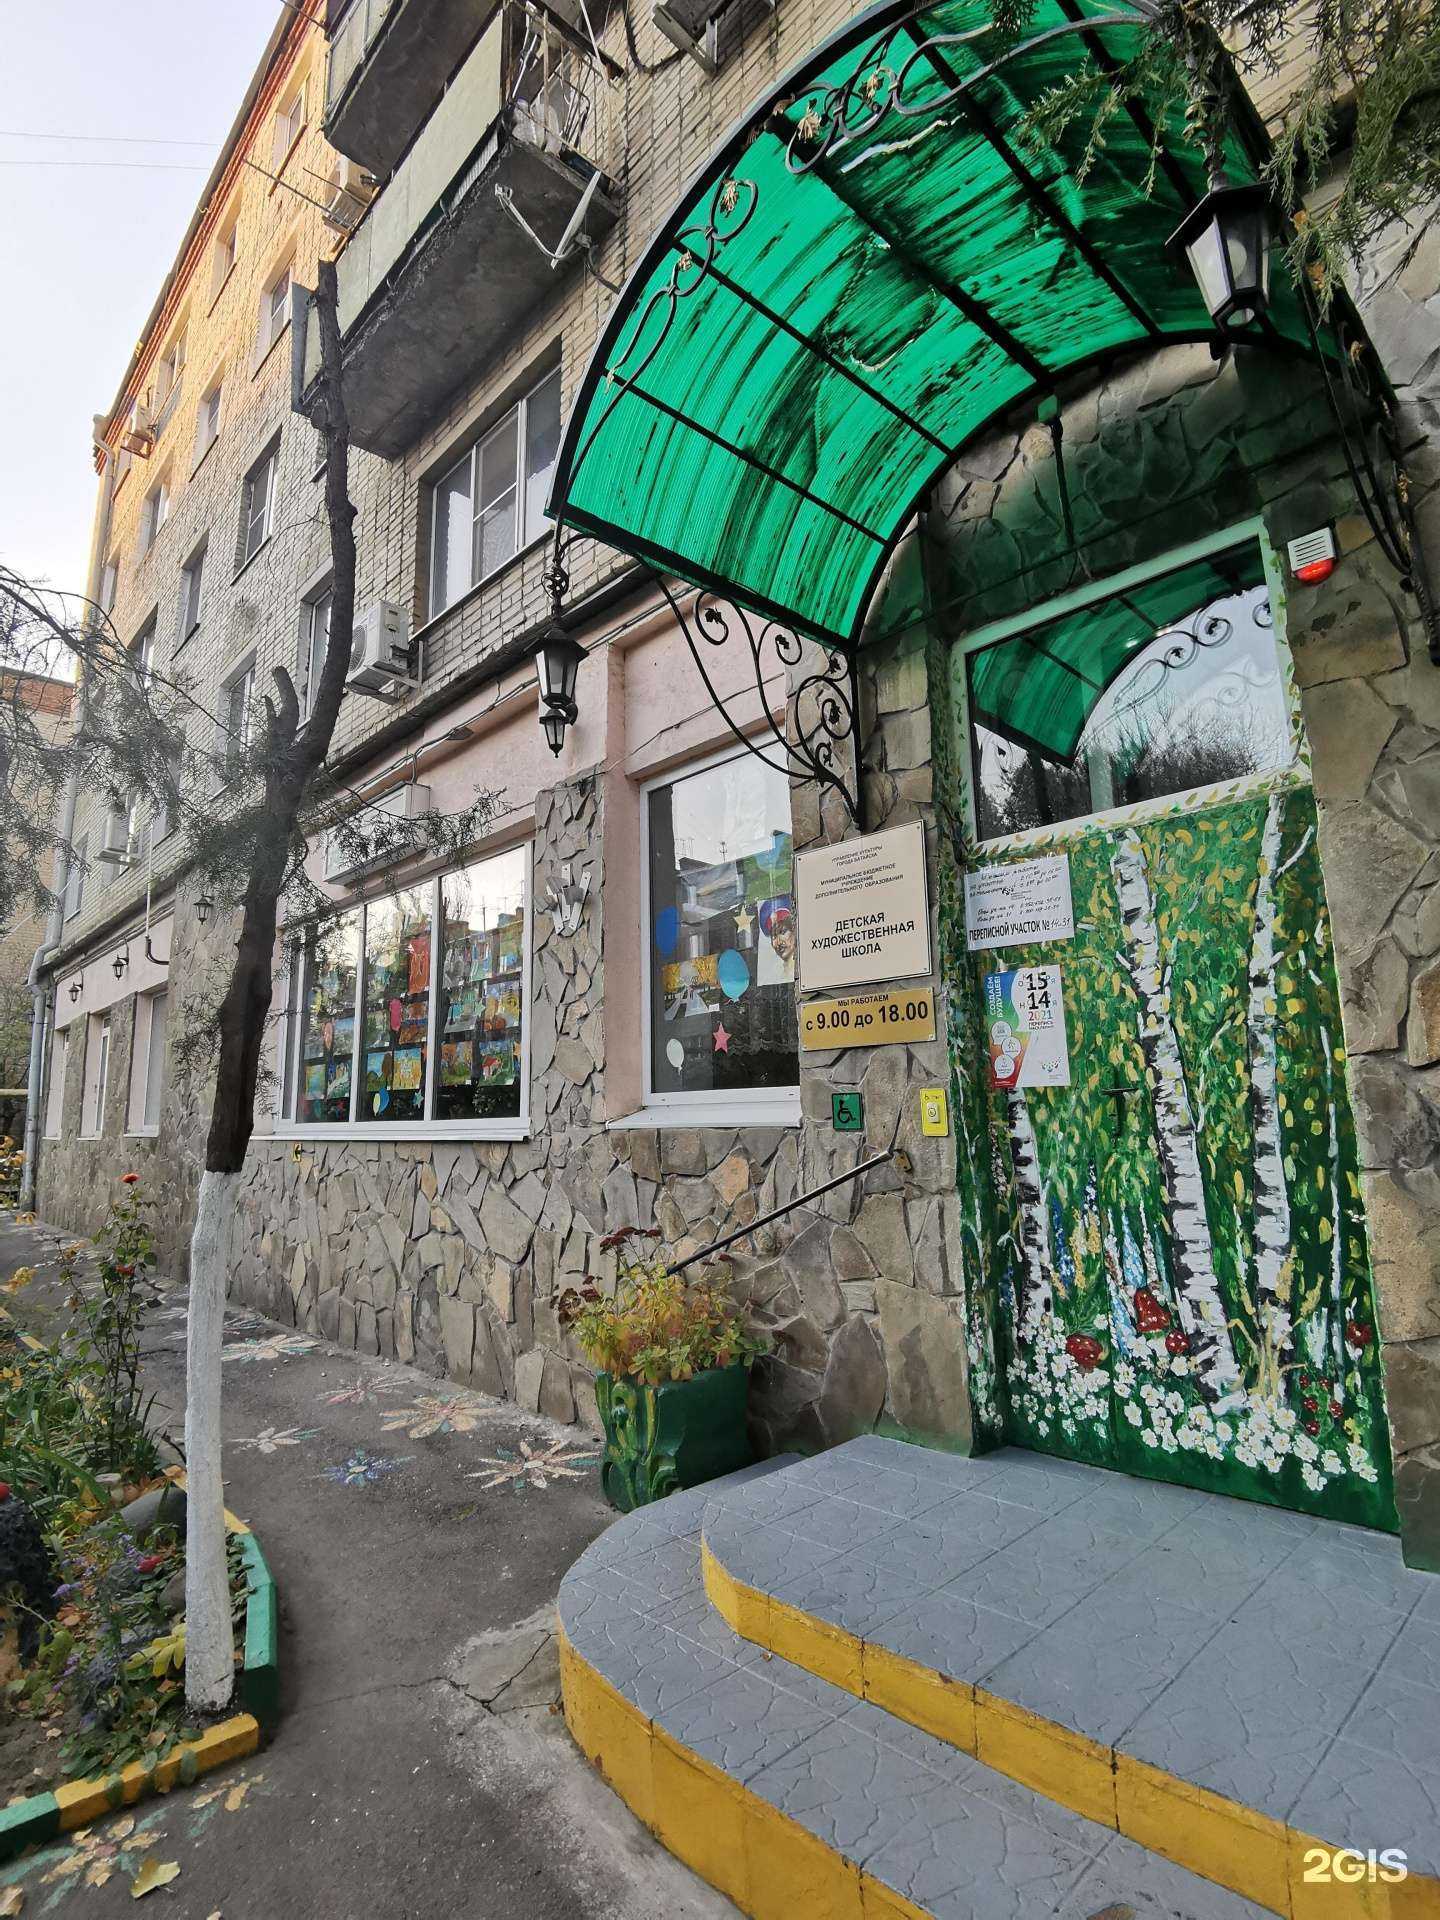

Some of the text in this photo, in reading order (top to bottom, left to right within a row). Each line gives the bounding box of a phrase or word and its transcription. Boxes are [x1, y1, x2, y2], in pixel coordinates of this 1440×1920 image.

[820, 863, 896, 886] МУНИЦИПАЛЬНОЕ БЮДЖЕТНОЕ
[841, 875, 874, 887] УЧРЕЖДЕНИЕ
[815, 874, 904, 900] ДОПОЛНИТЕЛЬНОГО ОБРАЗОВАНИЯ
[835, 912, 885, 933] ДЕТСКАЯ
[969, 922, 1009, 941] ПЕРЕПИСНОЙ
[1011, 920, 1040, 936] УЧАСТОК
[811, 920, 915, 950] ХУДОЖЕСТВЕННАЯ
[841, 942, 882, 958] ШКОЛА
[1026, 971, 1048, 991] 15
[850, 994, 889, 1006] РАБОТАЕМ
[1027, 990, 1051, 1010] 14
[805, 1001, 928, 1031] с 9.00 до 18.00
[1028, 1010, 1053, 1021] 2021
